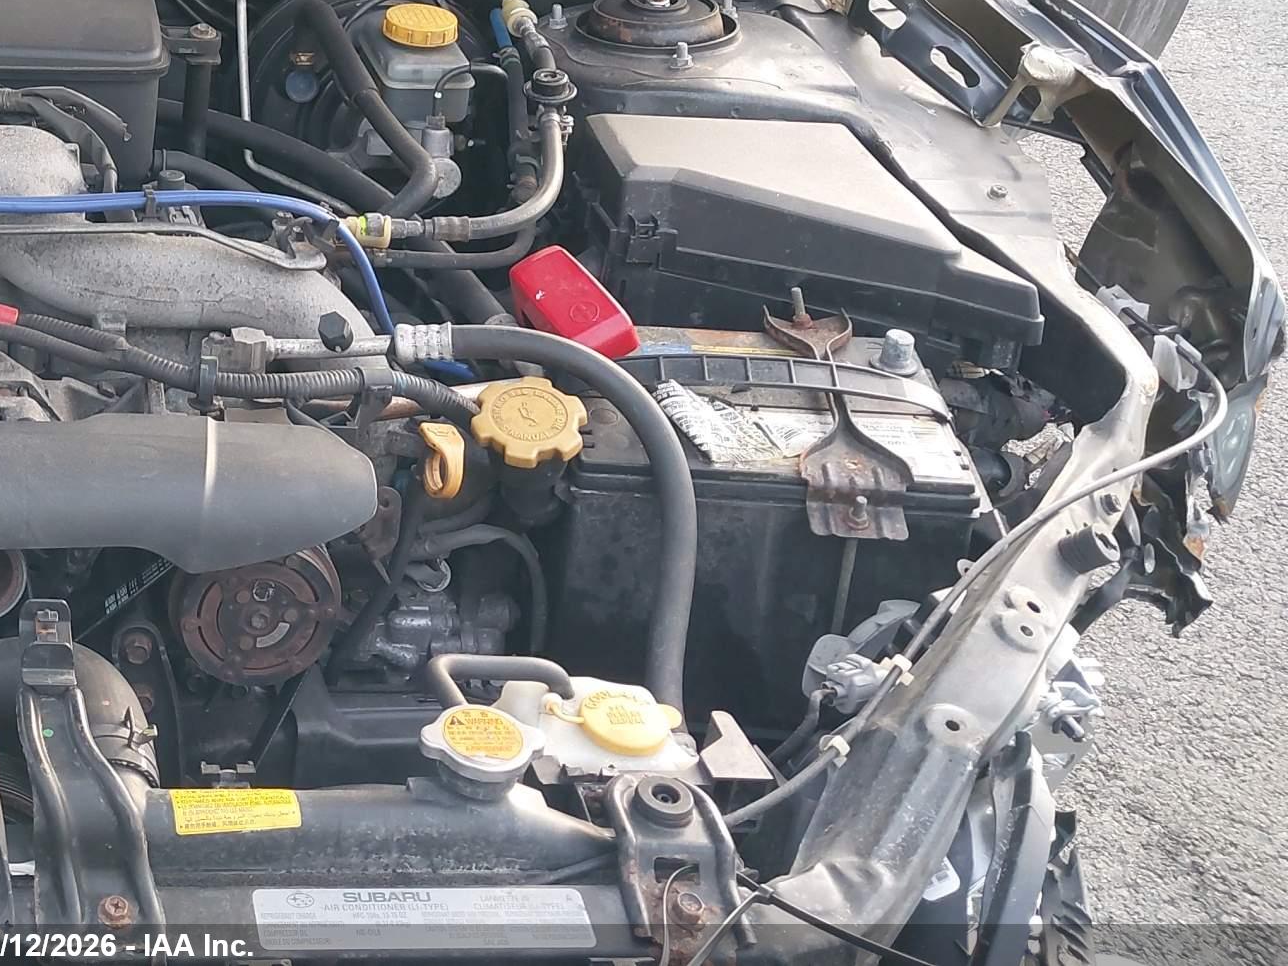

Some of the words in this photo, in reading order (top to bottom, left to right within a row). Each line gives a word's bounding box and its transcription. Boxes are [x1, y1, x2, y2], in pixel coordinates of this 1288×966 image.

[343, 892, 432, 903] SUBARU
[323, 904, 340, 912] AIR
[342, 904, 406, 912] CONDITIONER
